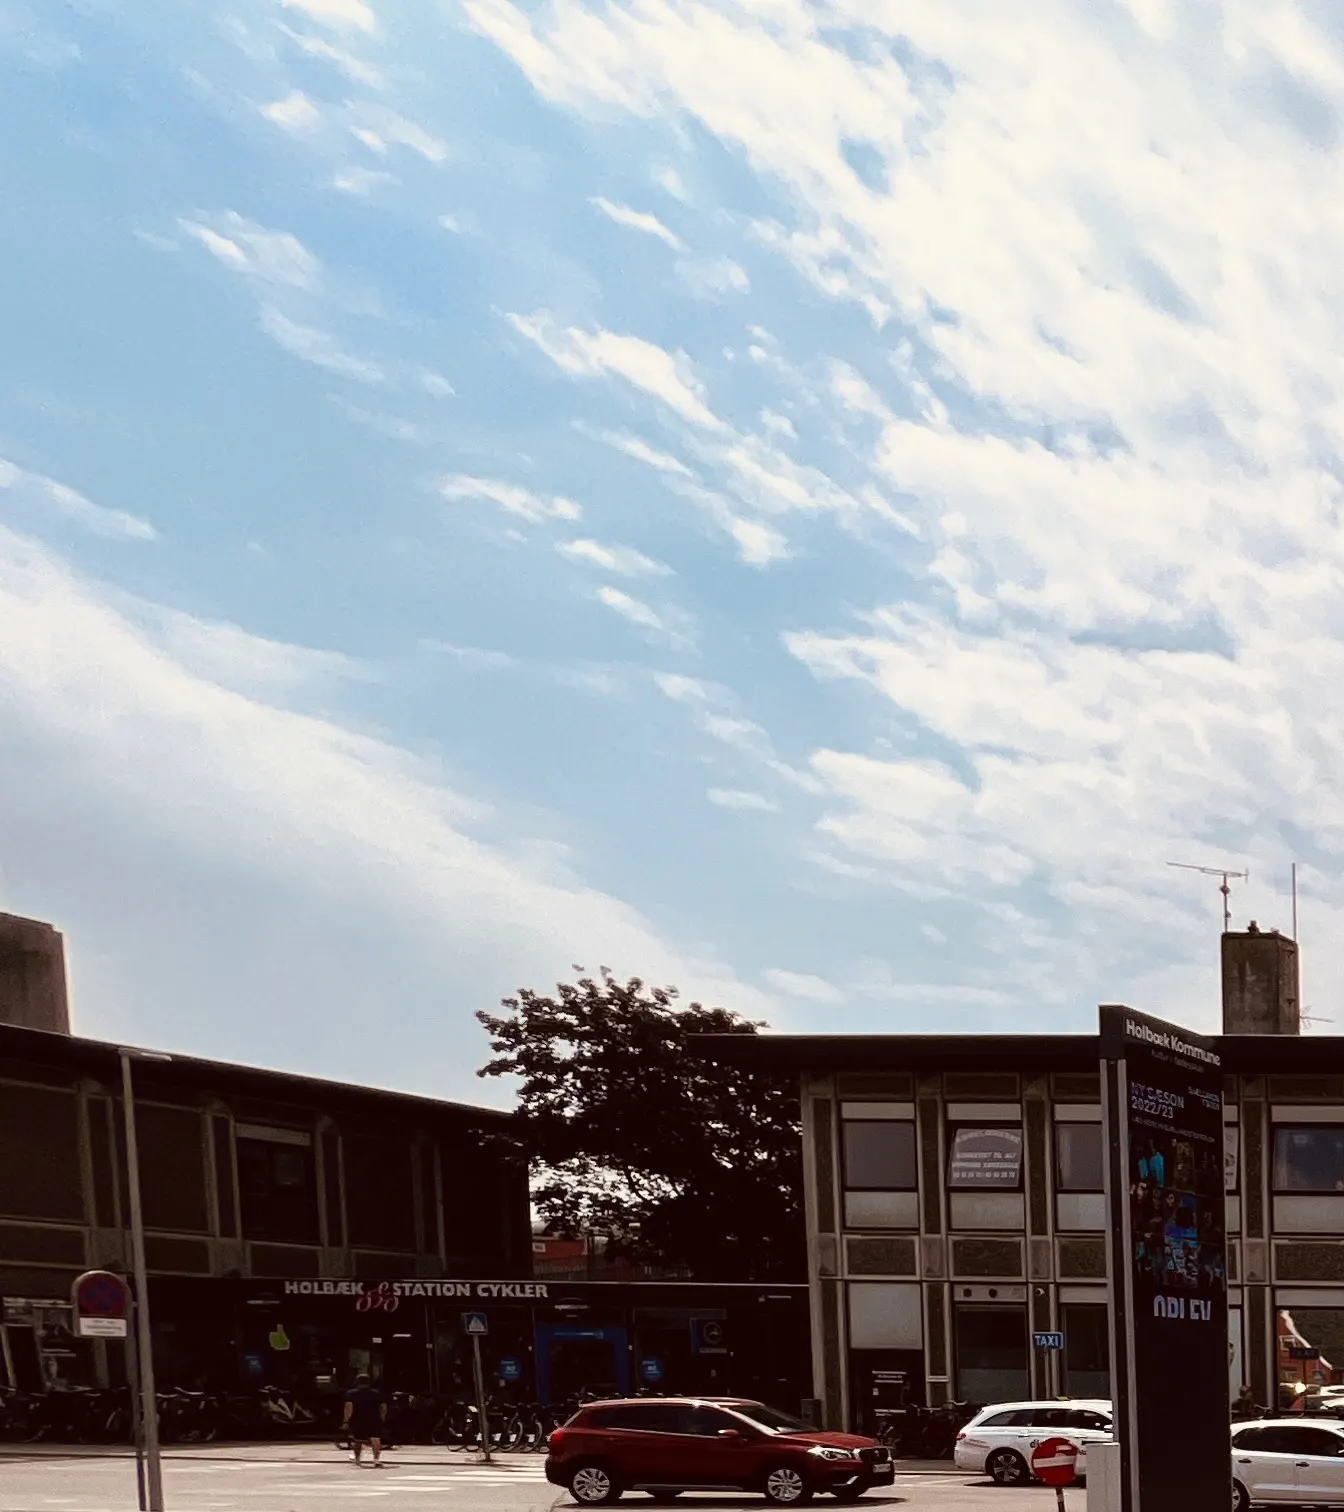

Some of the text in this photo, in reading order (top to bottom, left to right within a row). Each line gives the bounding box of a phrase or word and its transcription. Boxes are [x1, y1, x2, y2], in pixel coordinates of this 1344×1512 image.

[1126, 1018, 1170, 1049] Holbæk
[1170, 1034, 1221, 1067] Kommune
[1131, 1096, 1174, 1119] 2022/23
[284, 1281, 549, 1298] HOLBÆK STATION CYKLER
[1034, 1335, 1059, 1347] TAXI
